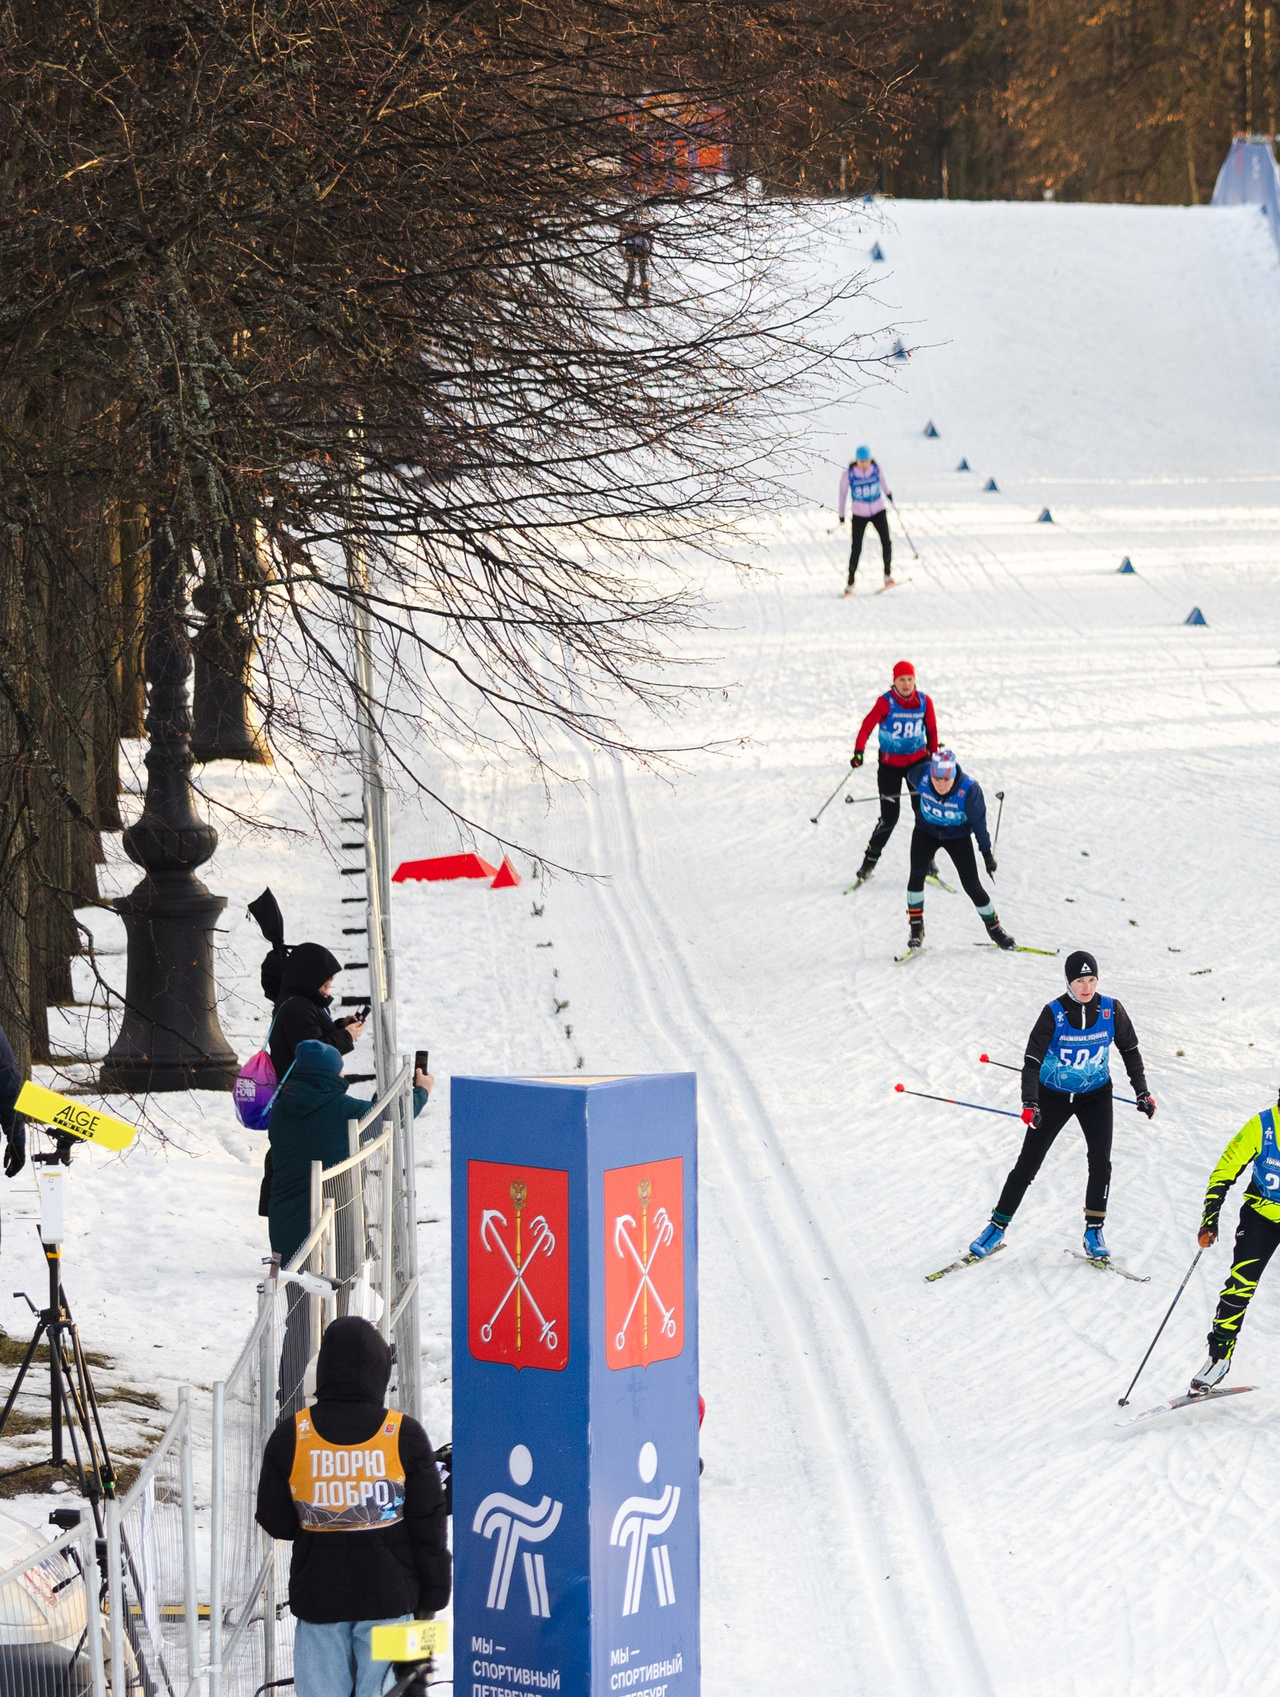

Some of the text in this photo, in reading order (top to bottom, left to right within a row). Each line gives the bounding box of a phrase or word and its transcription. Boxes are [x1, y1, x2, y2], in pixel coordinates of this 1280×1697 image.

[1058, 1046, 1105, 1070] 504
[56, 1105, 101, 1132] ALGE
[310, 1449, 386, 1478] ТВОРЮ
[312, 1480, 390, 1507] ДОБРО
[472, 1635, 493, 1655] МЫ
[610, 1646, 629, 1667] МЫ
[472, 1659, 560, 1690] СПОРТИВНЫЙ
[611, 1652, 683, 1691] СПОРТИВНЫЙ
